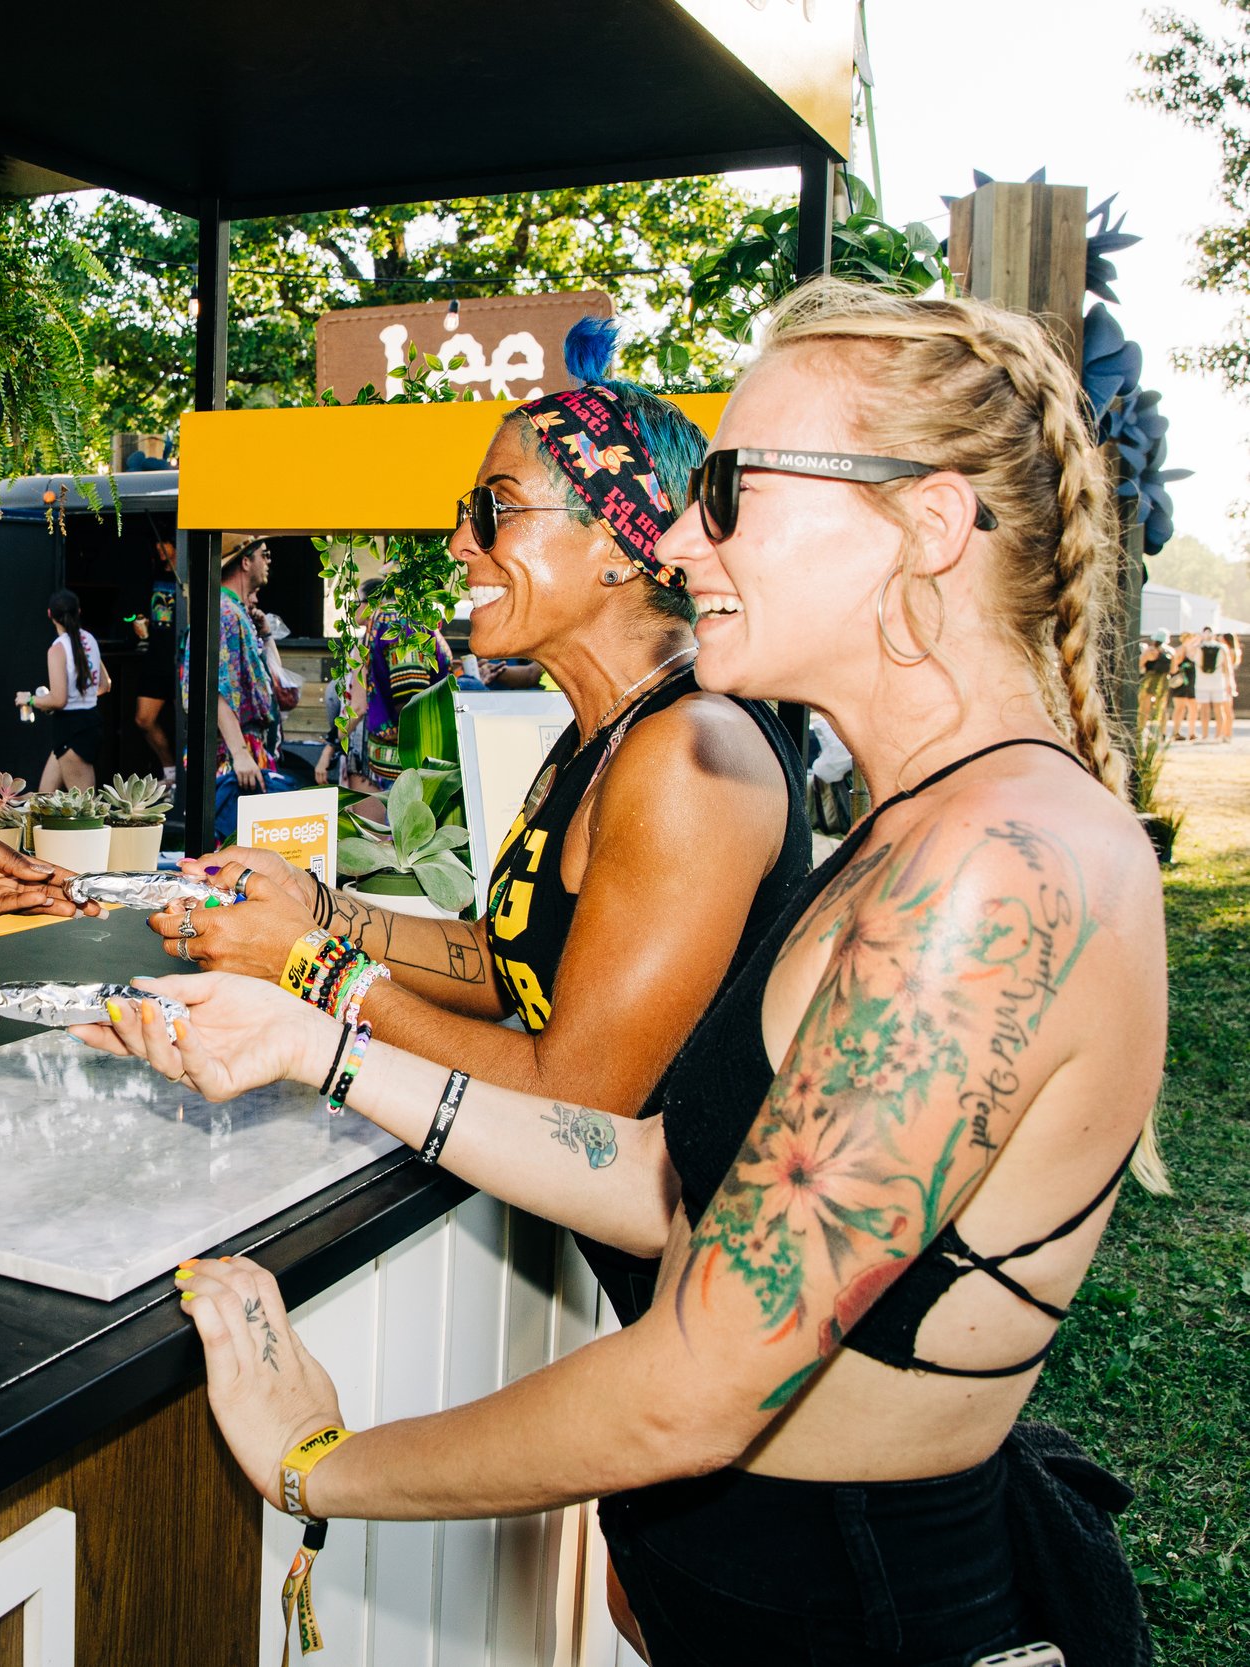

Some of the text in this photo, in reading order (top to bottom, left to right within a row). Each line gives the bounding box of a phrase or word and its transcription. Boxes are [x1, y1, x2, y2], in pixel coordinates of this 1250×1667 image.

[379, 323, 545, 401] Lee
[555, 391, 609, 437] That!
[585, 398, 611, 422] Hit
[779, 453, 853, 472] MONACO
[607, 485, 637, 516] I'd
[254, 821, 325, 844] Free eggs
[1034, 883, 1072, 1012] Spirit
[288, 957, 308, 990] Thur
[990, 977, 1037, 1066] Wild
[437, 1103, 455, 1131] Shine
[300, 1430, 339, 1453] Thur
